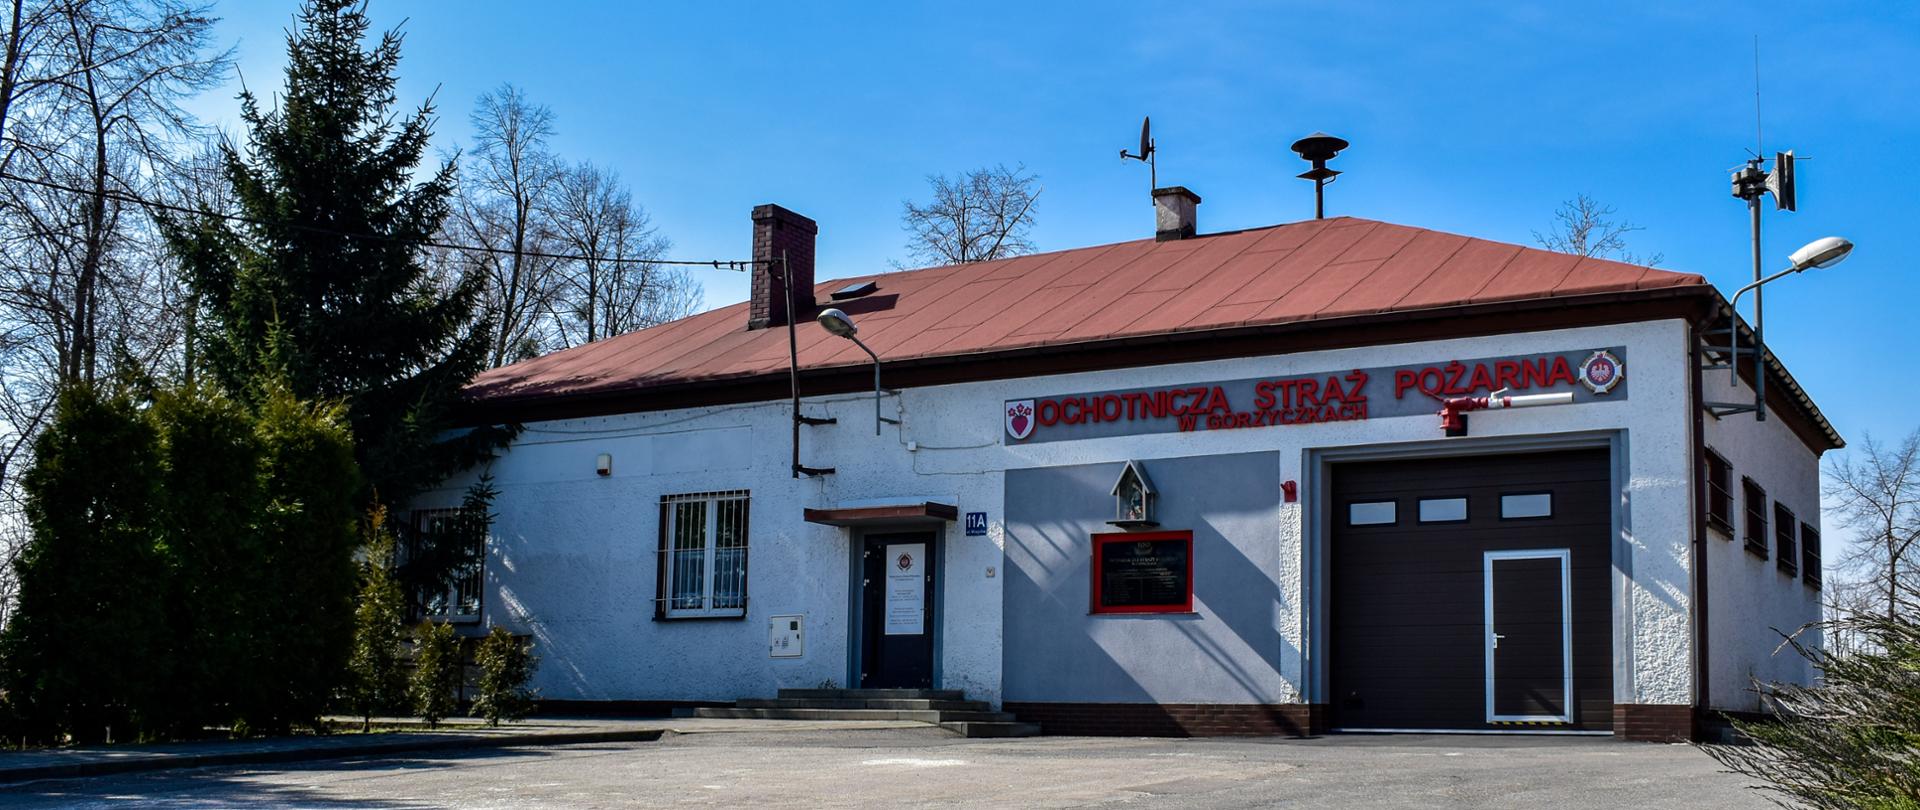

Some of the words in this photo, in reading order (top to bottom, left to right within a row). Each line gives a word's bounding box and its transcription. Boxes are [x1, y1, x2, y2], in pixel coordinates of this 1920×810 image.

[1037, 386, 1232, 427] OCHOTNICZA
[1254, 369, 1369, 410] STRAŻ
[1394, 355, 1575, 400] POŻARNA
[1177, 414, 1198, 433] W
[1206, 402, 1369, 431] GORZYCZKACH
[966, 514, 986, 528] 11A
